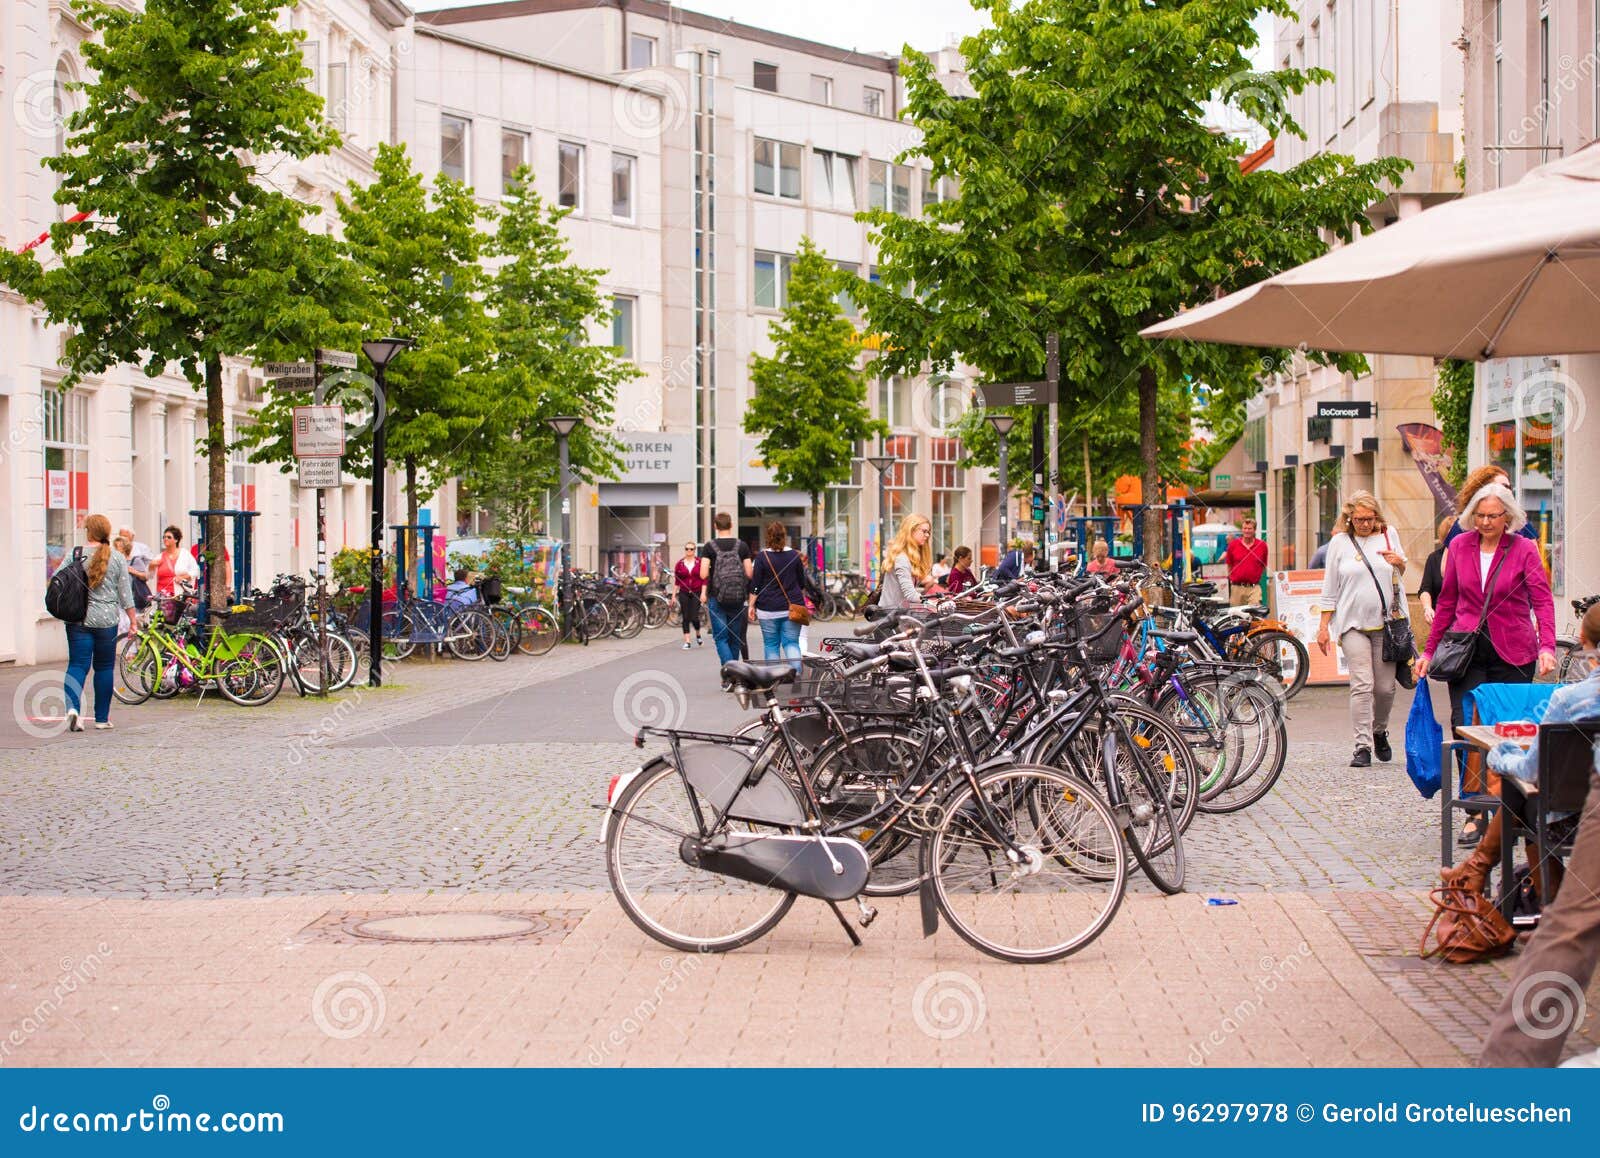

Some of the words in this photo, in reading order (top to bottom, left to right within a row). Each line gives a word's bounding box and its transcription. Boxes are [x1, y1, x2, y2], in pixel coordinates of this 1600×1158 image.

[267, 363, 311, 376] Wallgraben
[1320, 408, 1359, 417] BoConcept
[626, 442, 672, 453] ARKEN
[302, 460, 335, 468] Fahrräder
[626, 460, 671, 470] UTLET
